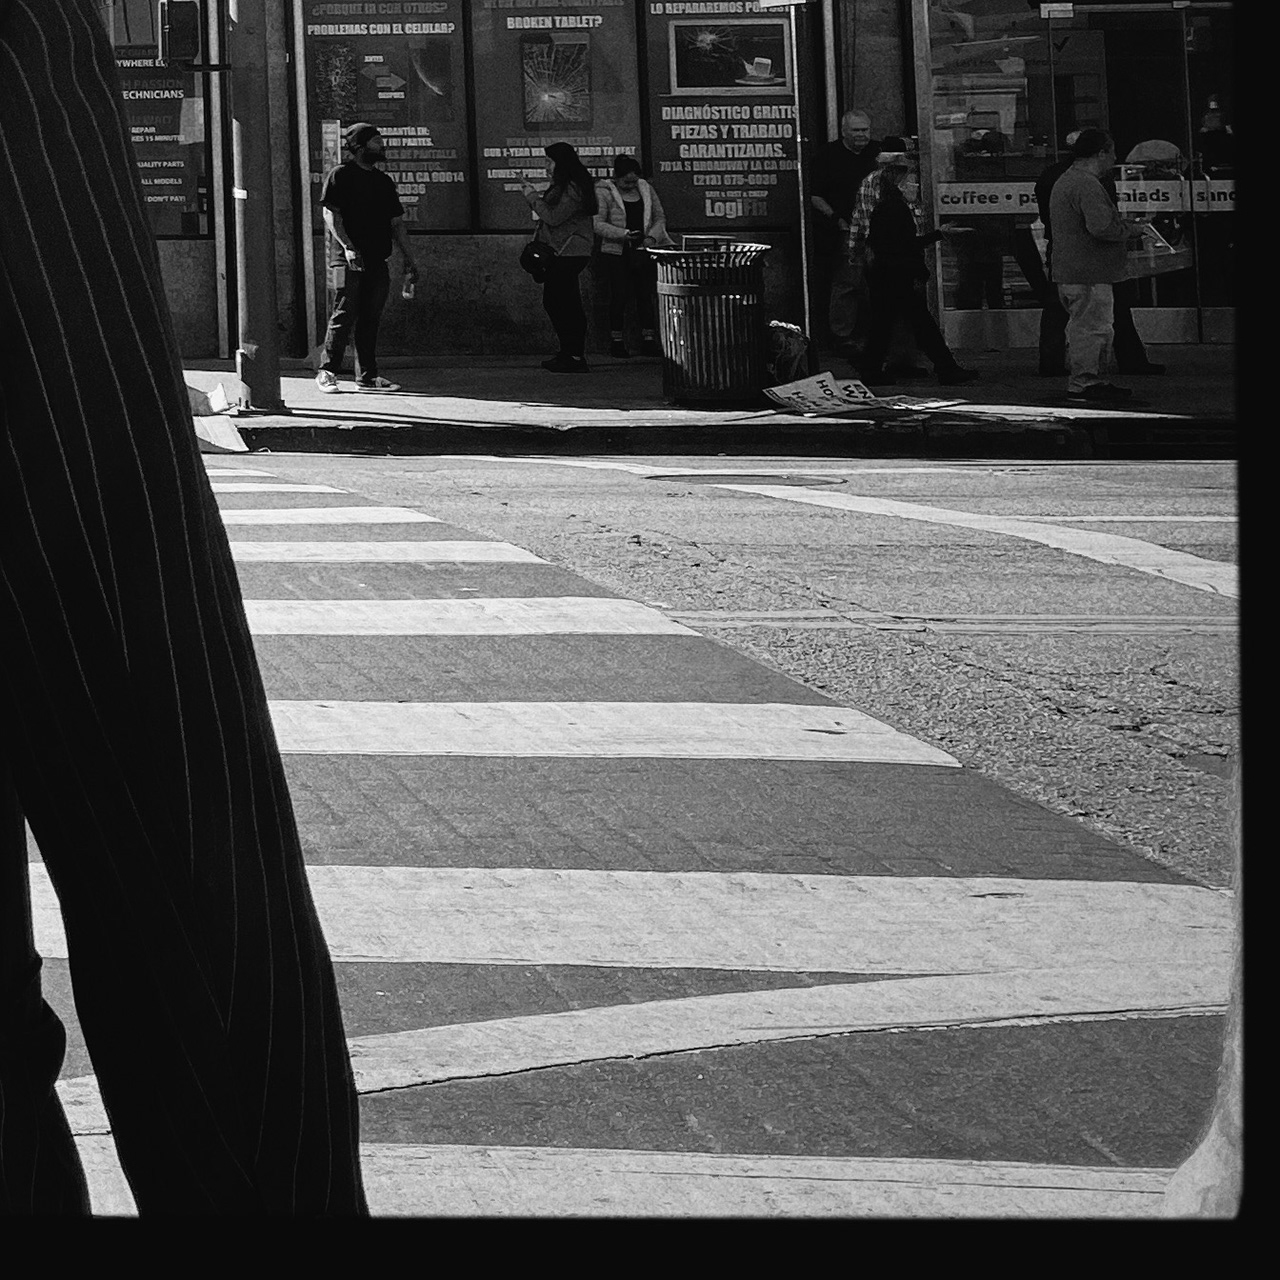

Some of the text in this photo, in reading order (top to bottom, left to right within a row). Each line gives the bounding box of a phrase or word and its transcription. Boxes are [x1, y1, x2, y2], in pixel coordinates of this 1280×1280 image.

[650, 2, 743, 14] LO REPARAREMOS
[307, 22, 455, 36] PROBLEMAS CON EL CELULAR?
[507, 15, 603, 29] BROKEN TABLET?
[116, 59, 154, 67] YWHERE
[123, 90, 185, 99] ECHNICIANS
[662, 104, 750, 120] DIAGNÓSTICO
[671, 124, 793, 139] PIEZAS Y TRABAJO
[679, 143, 787, 158] GARANTIZADAS.
[693, 160, 749, 171] BROADWAY
[750, 160, 762, 170] LA
[763, 160, 777, 170] CA
[941, 191, 999, 204] coffee
[705, 199, 767, 218] LogiFix
